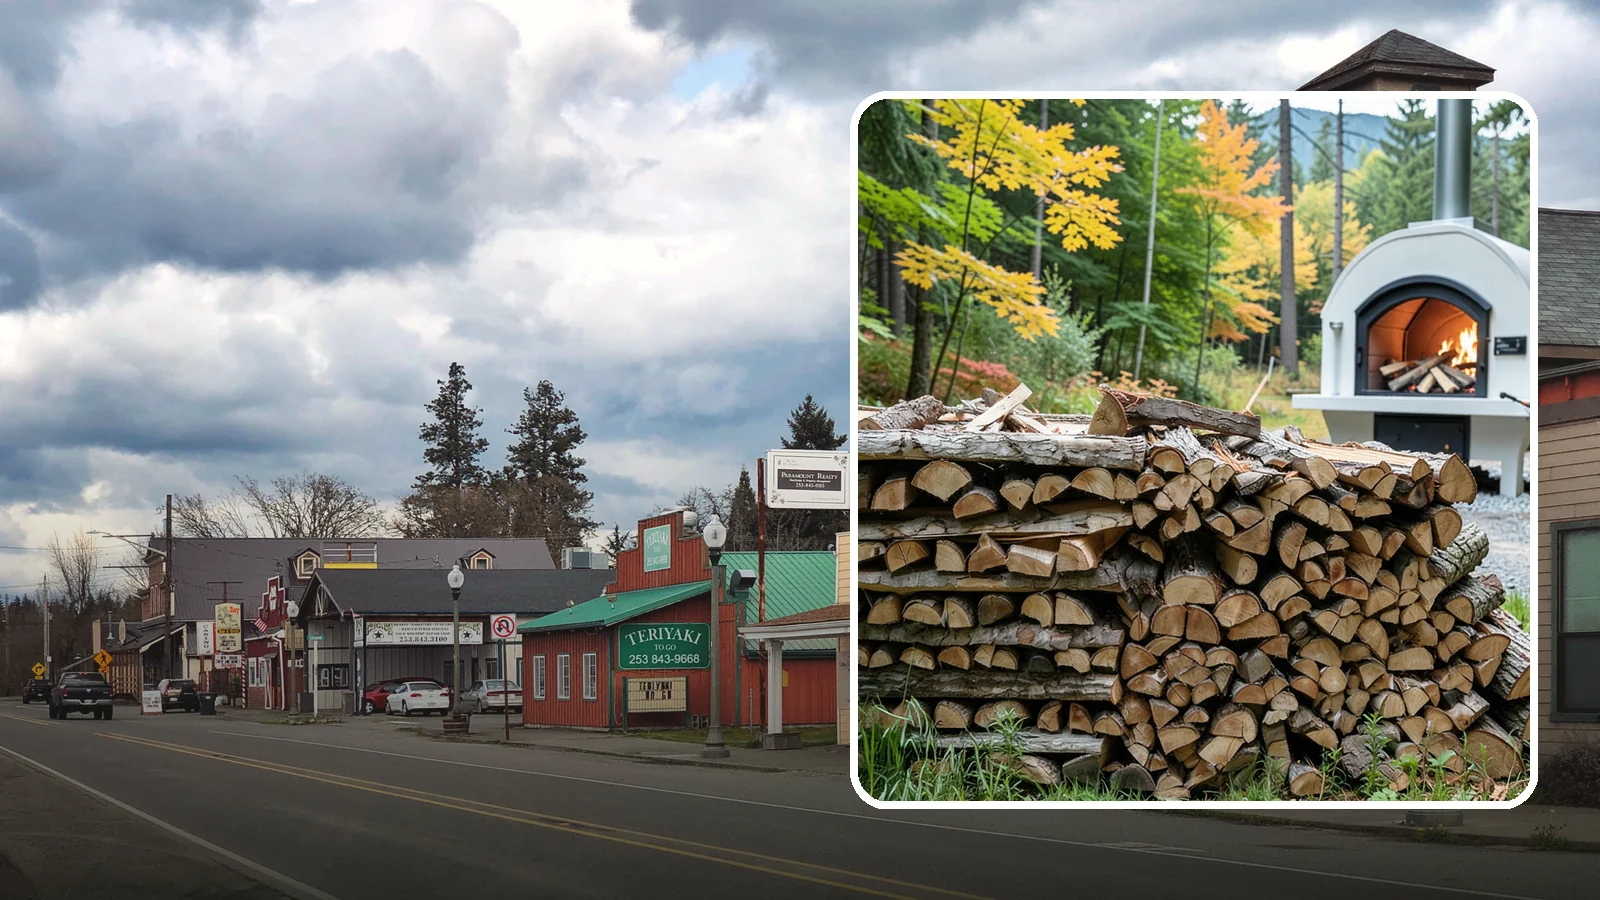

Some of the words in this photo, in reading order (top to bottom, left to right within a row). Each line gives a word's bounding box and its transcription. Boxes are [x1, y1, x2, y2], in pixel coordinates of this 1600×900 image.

[817, 472, 838, 480] REALTY
[625, 627, 702, 646] TERIYAKI
[665, 643, 676, 651] GO
[629, 654, 648, 664] 253
[651, 653, 699, 664] 843-9668
